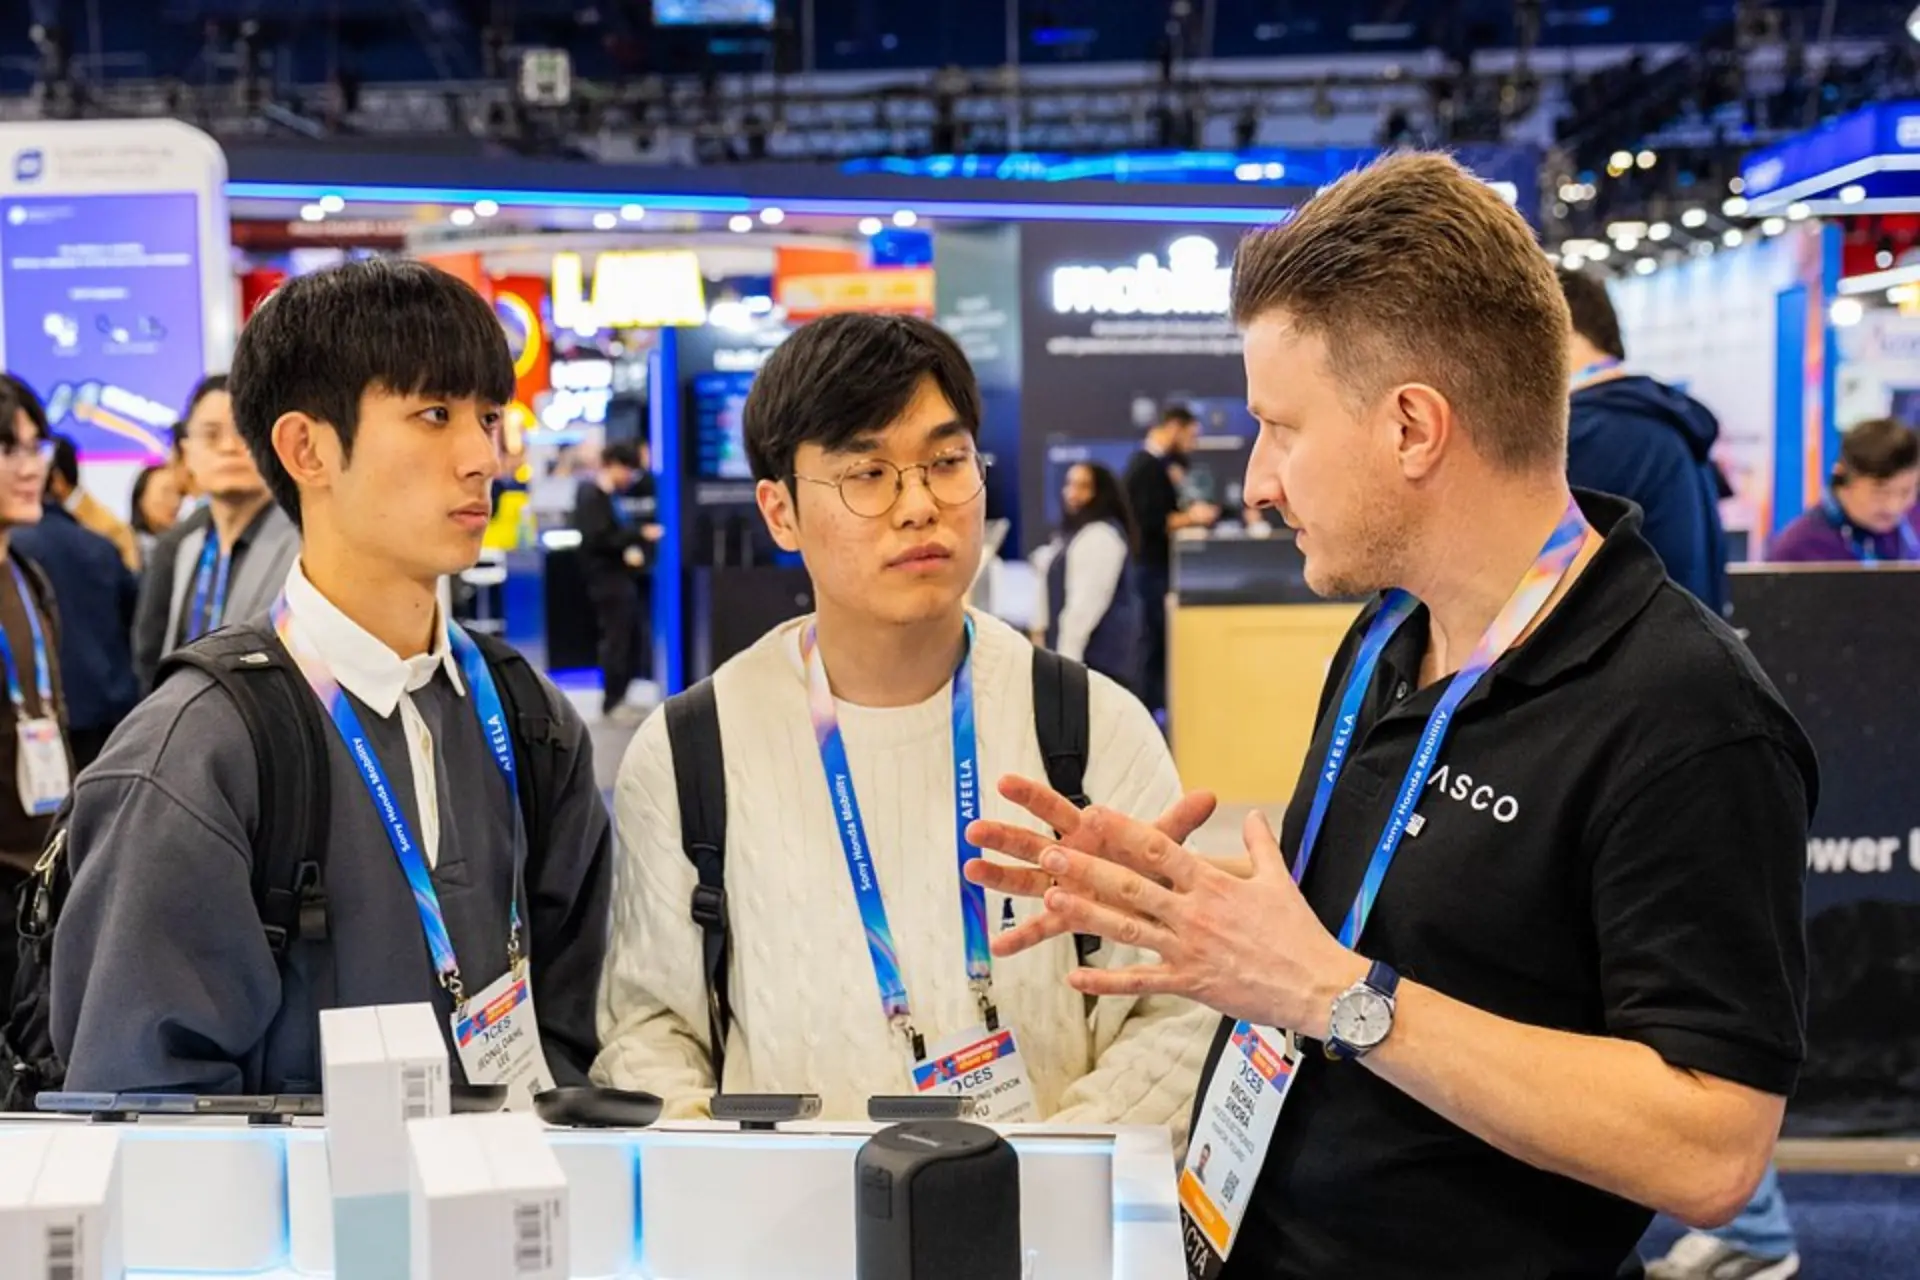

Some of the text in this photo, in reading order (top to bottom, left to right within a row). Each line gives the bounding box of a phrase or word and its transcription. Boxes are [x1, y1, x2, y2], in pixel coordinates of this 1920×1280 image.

[488, 714, 512, 771] AFEELA
[1325, 713, 1356, 783] AFEELA
[352, 737, 412, 852] Sony Honda Mobility
[960, 758, 974, 819] AFEELA
[1382, 710, 1448, 853] Sony Honda Mobility
[1427, 764, 1519, 822] ASCO
[835, 773, 873, 892] Sony Honda Mobility
[1806, 836, 1900, 874] wer
[963, 1066, 994, 1089] CES
